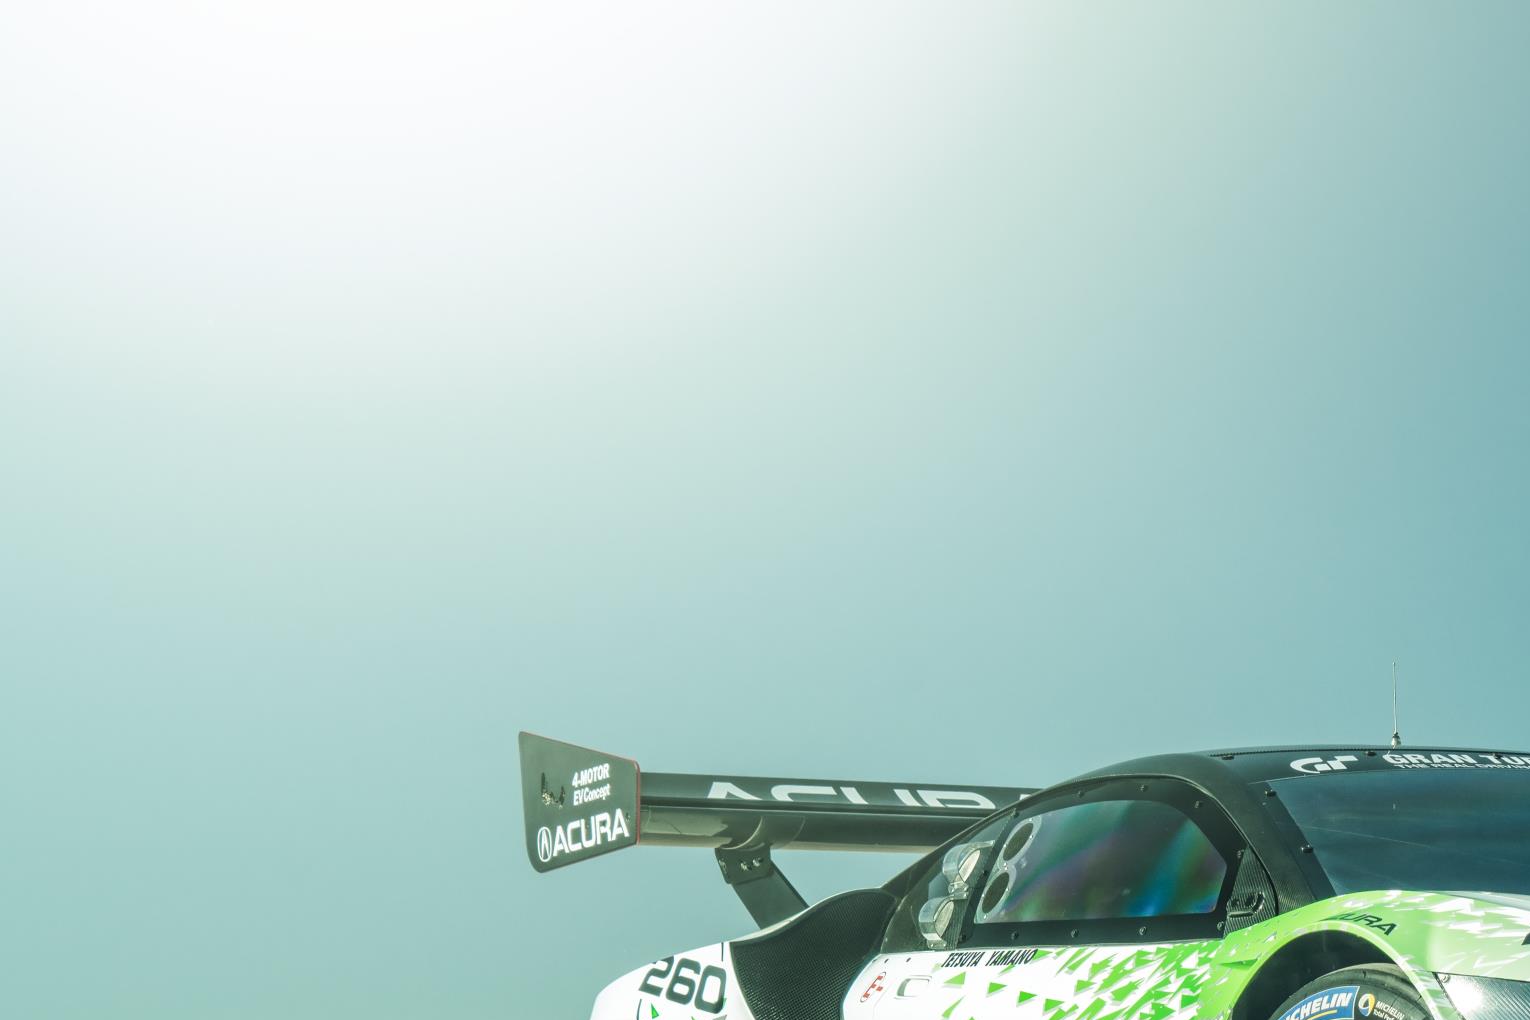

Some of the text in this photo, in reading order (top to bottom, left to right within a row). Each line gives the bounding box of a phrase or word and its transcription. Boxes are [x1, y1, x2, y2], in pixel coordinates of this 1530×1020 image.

[1382, 754, 1478, 765] GRAN
[571, 763, 610, 788] 4-MOTOR
[553, 808, 630, 857] ACURA
[941, 948, 1039, 968] TETSUYA YAMANO
[638, 955, 727, 1014] 260
[1374, 1001, 1405, 1020] MICHELIN
